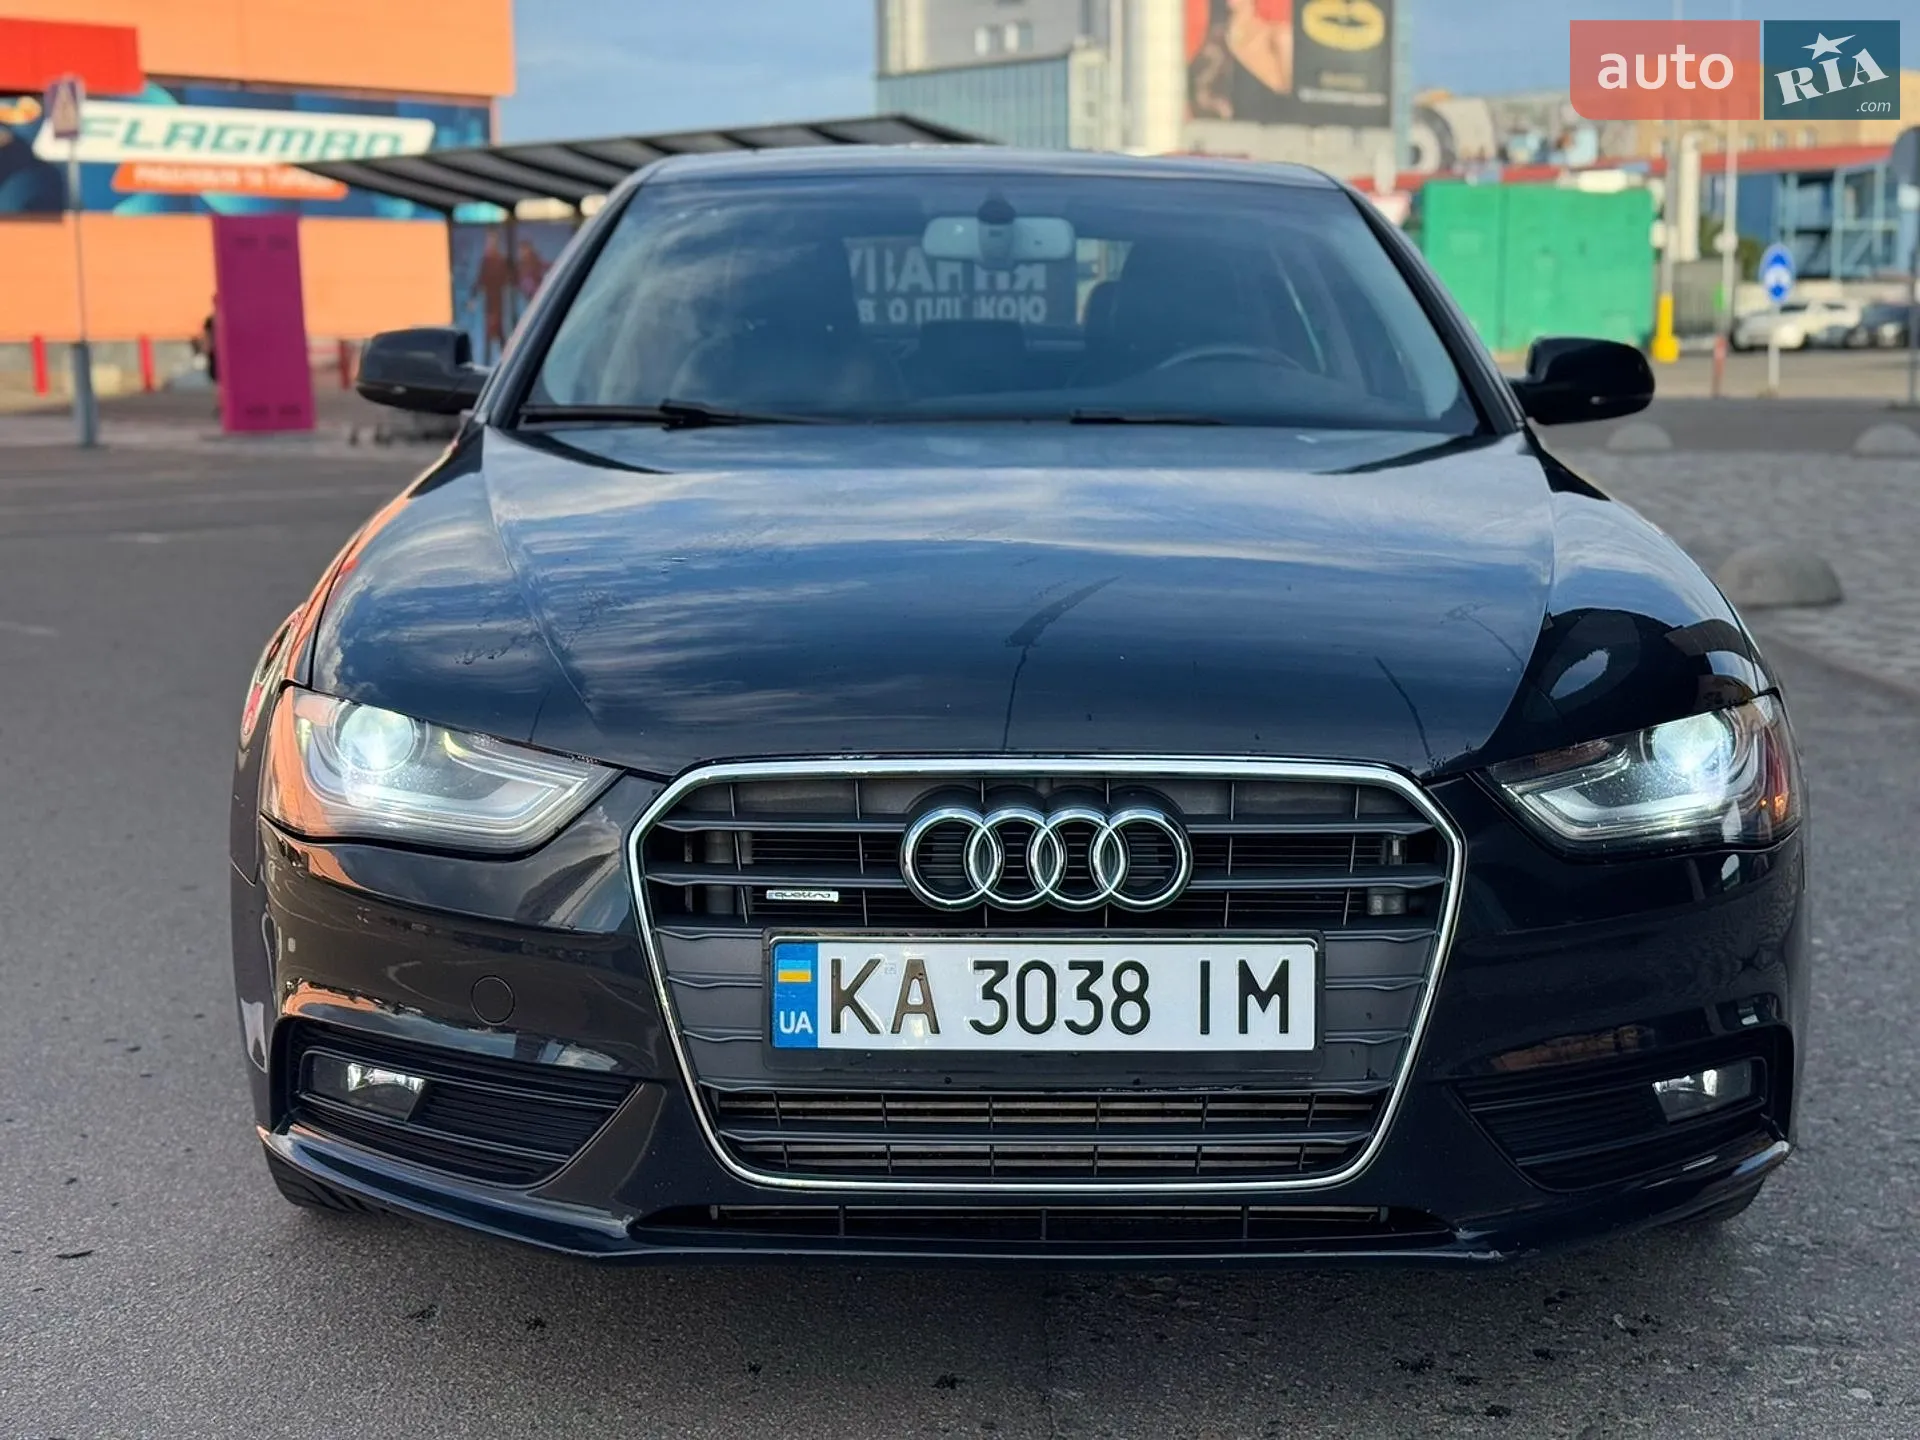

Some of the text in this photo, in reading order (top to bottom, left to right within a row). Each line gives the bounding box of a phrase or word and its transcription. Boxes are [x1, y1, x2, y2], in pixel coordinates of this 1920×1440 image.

[831, 958, 1290, 1036] KA 3038 IM
[779, 1011, 813, 1034] UA
